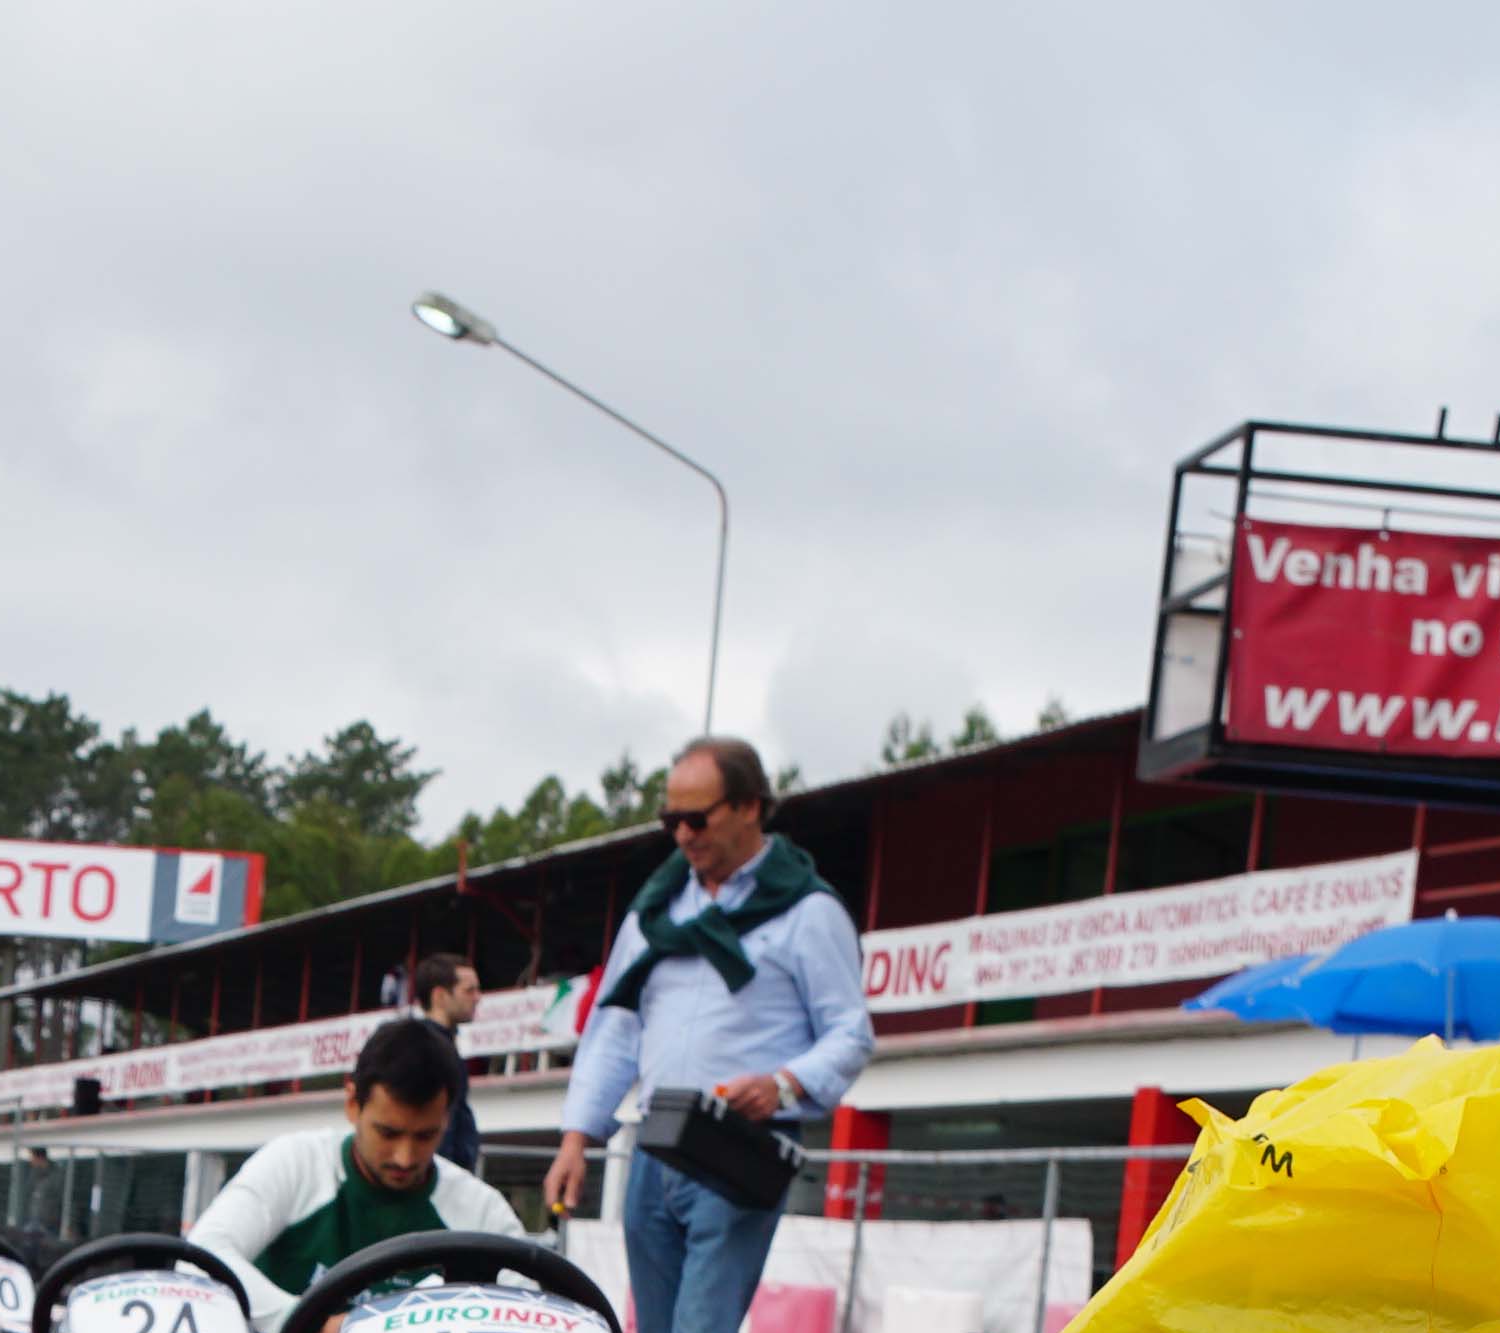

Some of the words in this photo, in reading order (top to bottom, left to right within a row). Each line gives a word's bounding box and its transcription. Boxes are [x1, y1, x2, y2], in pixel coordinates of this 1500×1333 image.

[1245, 534, 1430, 600] Venha
[1409, 615, 1484, 659] no
[93, 1283, 217, 1303] EUROINDY
[383, 1305, 583, 1333] EUROINDY
